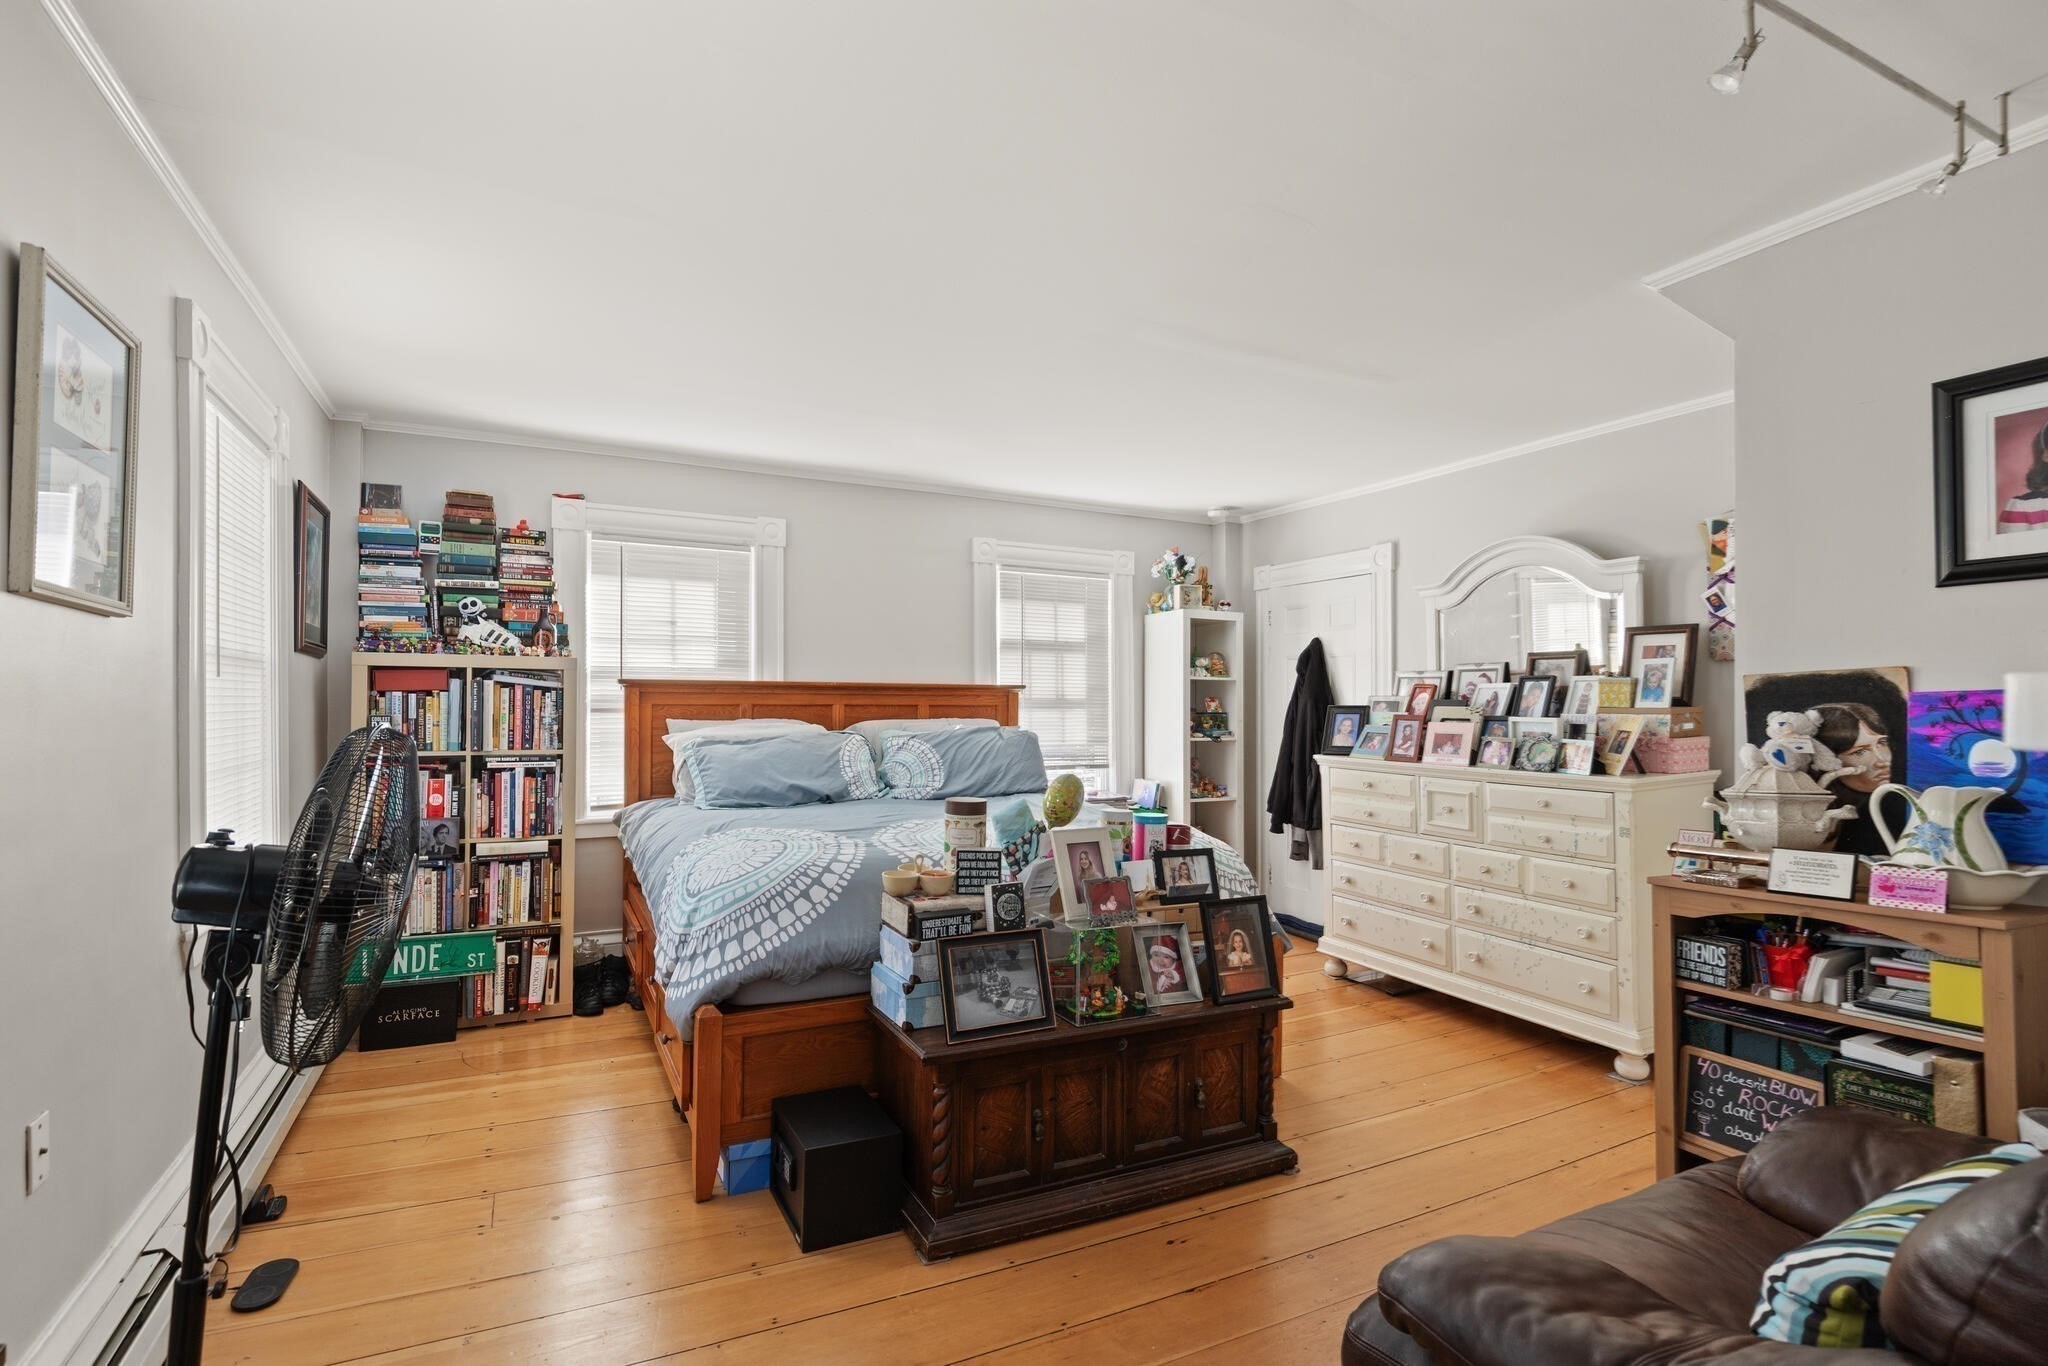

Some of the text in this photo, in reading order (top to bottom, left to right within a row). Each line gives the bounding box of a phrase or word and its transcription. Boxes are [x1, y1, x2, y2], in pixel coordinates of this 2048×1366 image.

[921, 914, 972, 929] UNDERESTIMATE ME
[921, 923, 972, 940] THAT'LL BE FUN
[467, 952, 486, 968] ST
[1676, 939, 1727, 968] FRIENDS
[531, 961, 540, 997] COOKING
[1714, 976, 1727, 988] LIFE
[377, 1009, 441, 1024] SCARFACE
[402, 1006, 428, 1014] PACINO
[1696, 1057, 1722, 1079] 40
[1708, 1082, 1725, 1097] it
[1690, 1090, 1715, 1109] So
